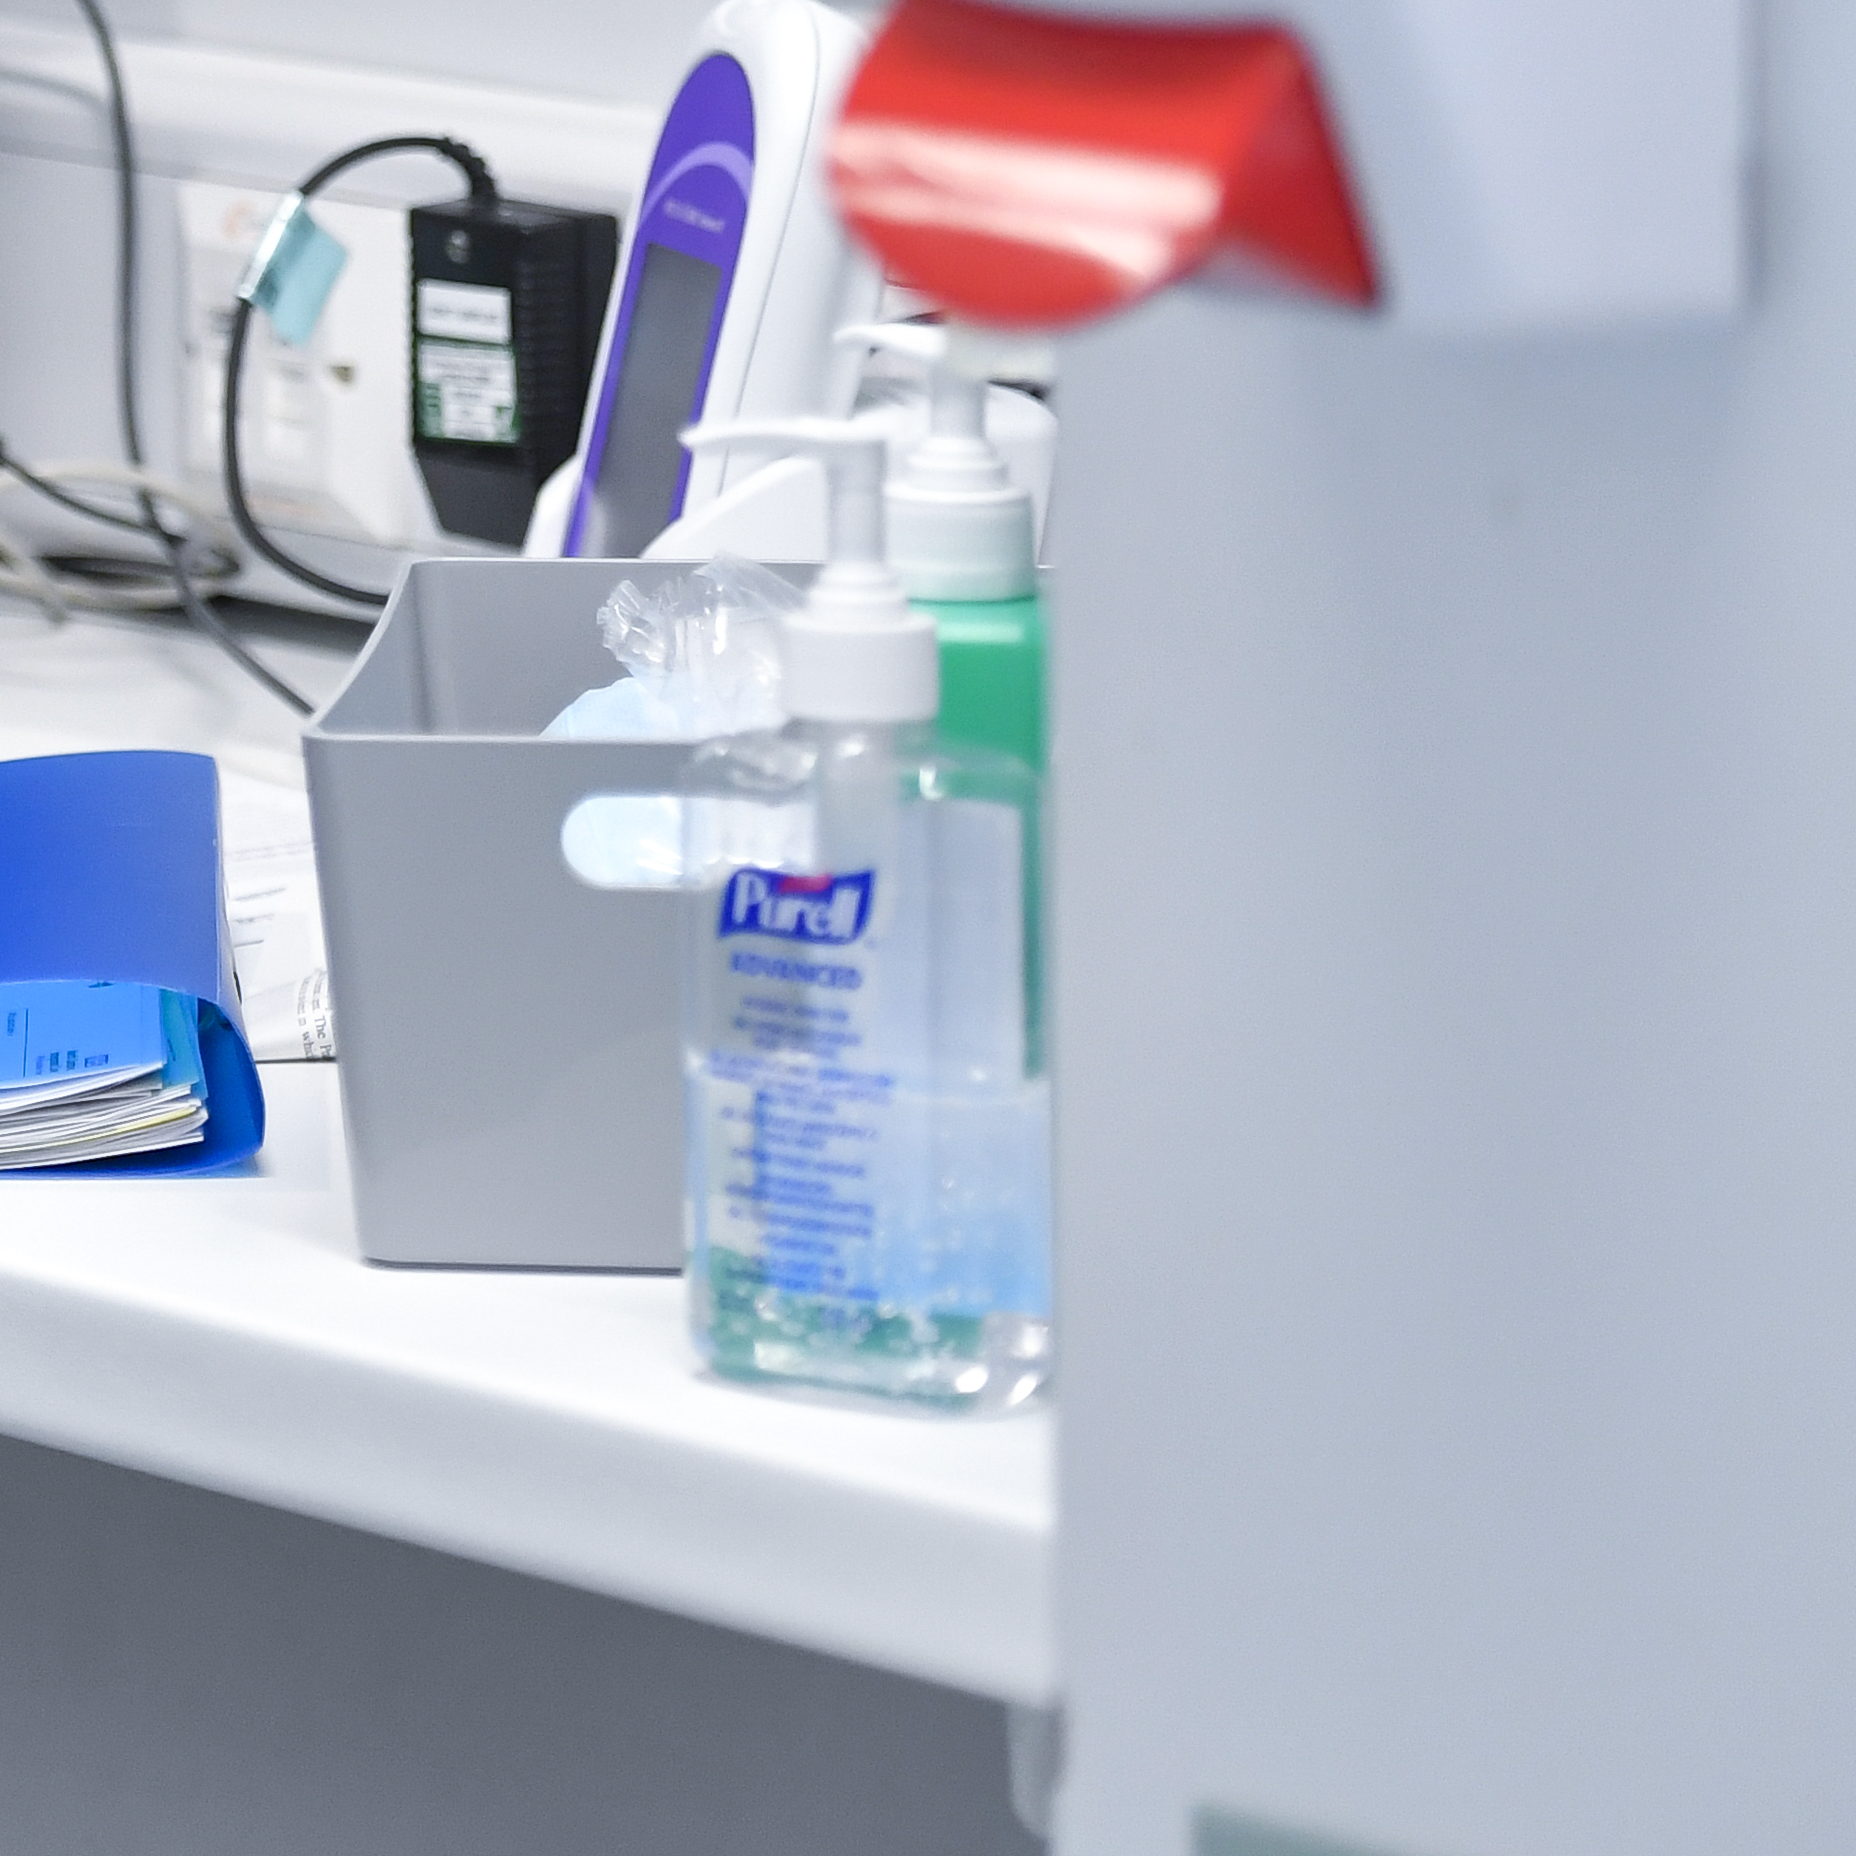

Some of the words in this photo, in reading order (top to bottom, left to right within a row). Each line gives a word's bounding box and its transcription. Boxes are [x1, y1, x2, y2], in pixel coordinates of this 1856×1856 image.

[734, 876, 862, 939] Purell
[731, 954, 863, 990] ADVANCED
[314, 1015, 327, 1040] The
